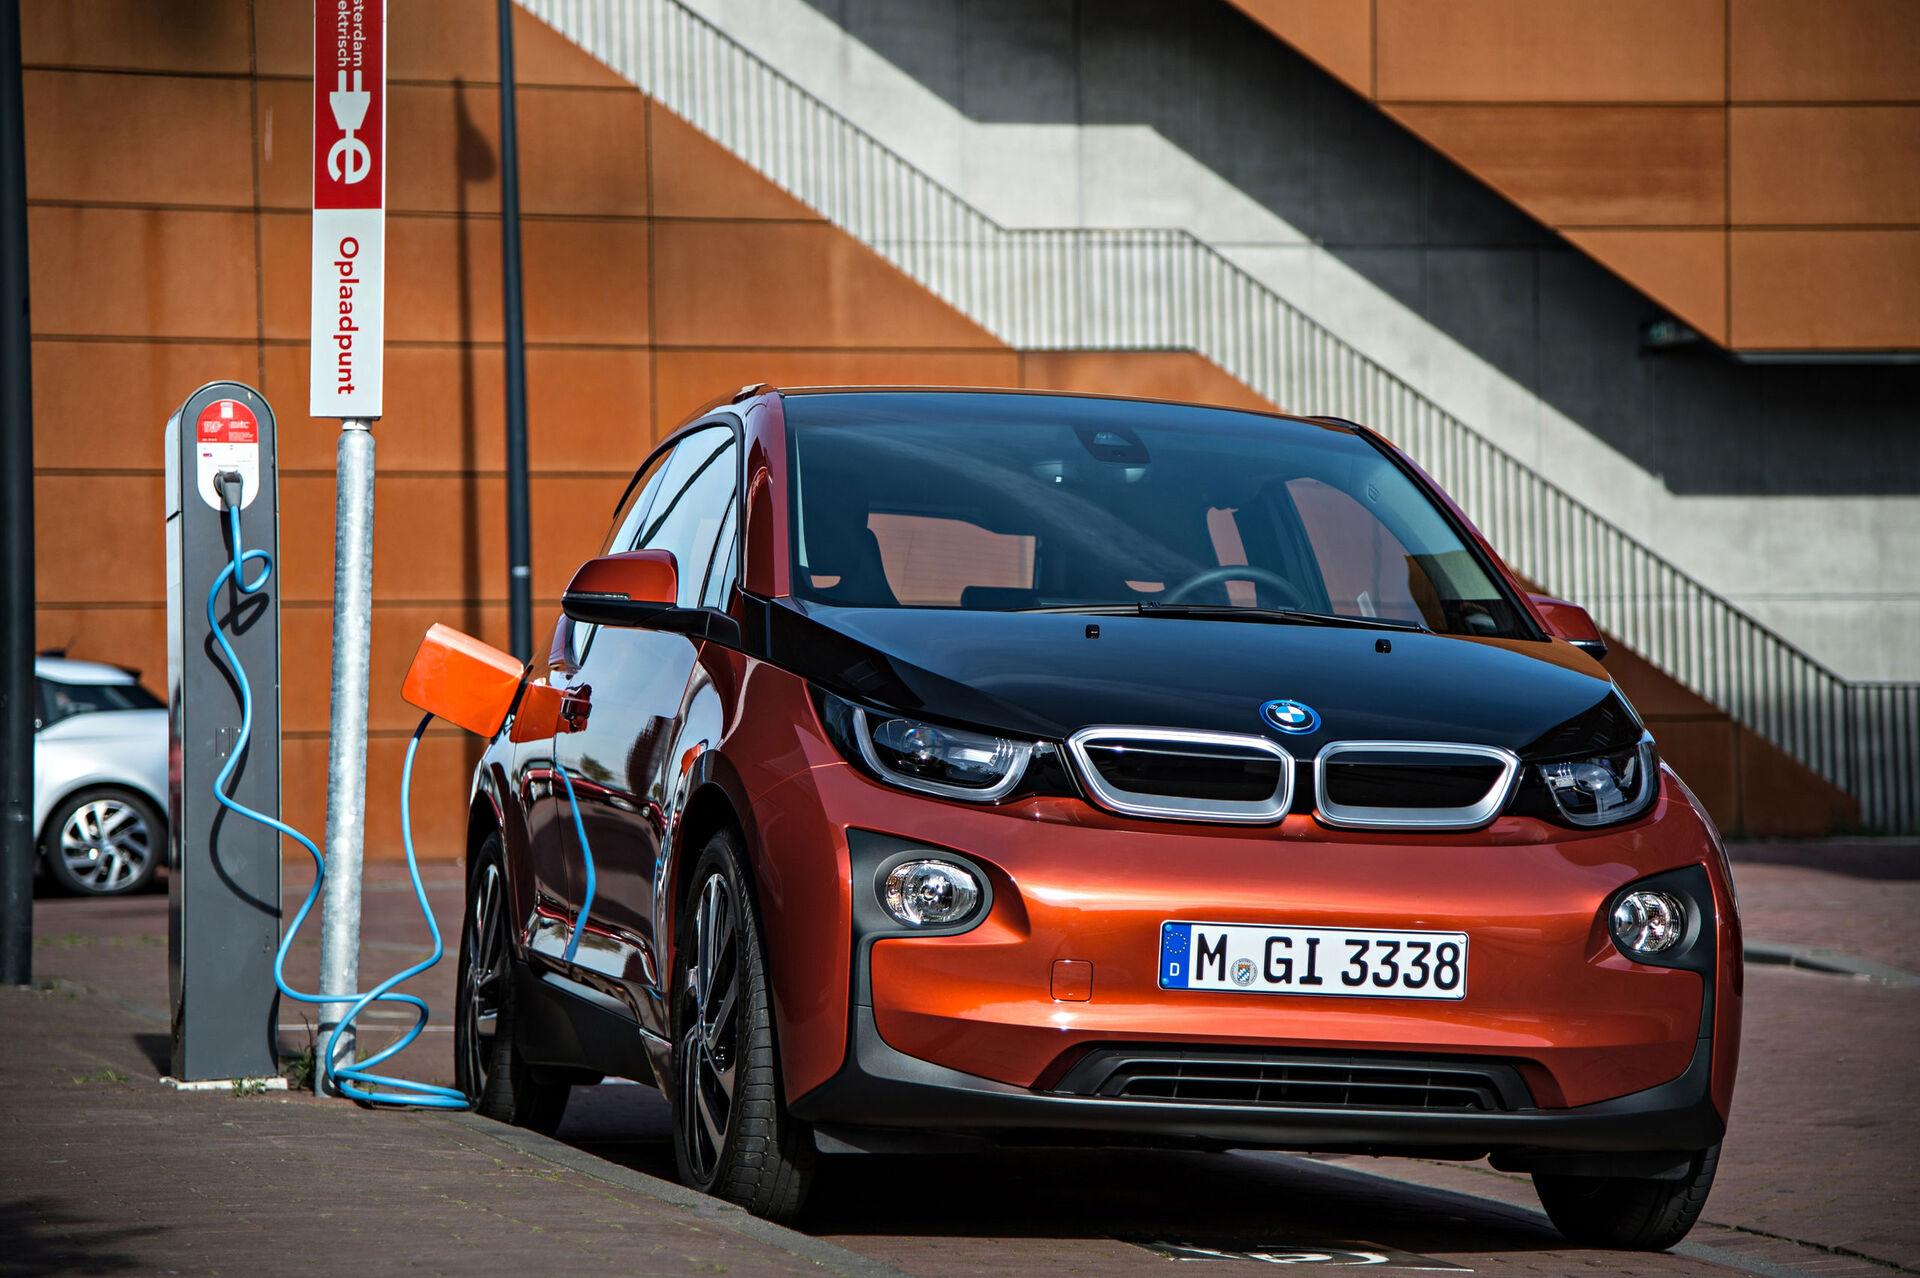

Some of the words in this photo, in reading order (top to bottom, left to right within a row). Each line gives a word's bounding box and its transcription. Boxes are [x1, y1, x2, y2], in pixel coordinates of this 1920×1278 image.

[337, 0, 351, 67] ektrisch
[333, 236, 360, 395] Oplaadpunt
[1169, 962, 1180, 976] D
[1195, 933, 1228, 981] M
[1262, 936, 1323, 986] GI
[1341, 939, 1460, 990] 3338
